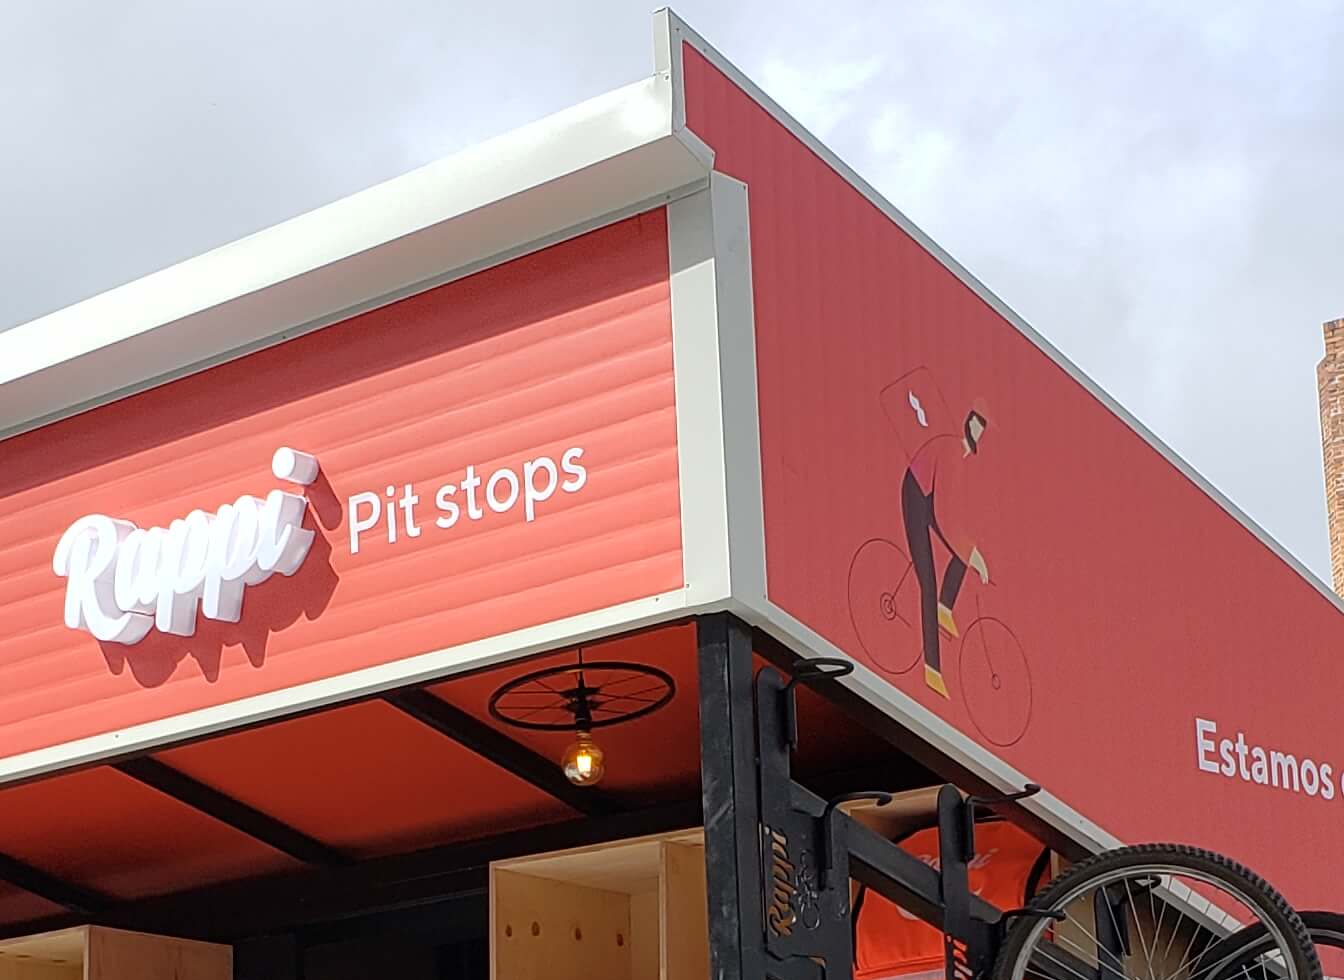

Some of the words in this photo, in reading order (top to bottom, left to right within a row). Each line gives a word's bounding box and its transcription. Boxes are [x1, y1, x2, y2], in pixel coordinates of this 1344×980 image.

[53, 446, 319, 645] Rappi
[347, 485, 422, 555] Pit
[435, 446, 588, 530] stops
[1194, 718, 1335, 800] Estamos
[764, 825, 798, 938] Rappi
